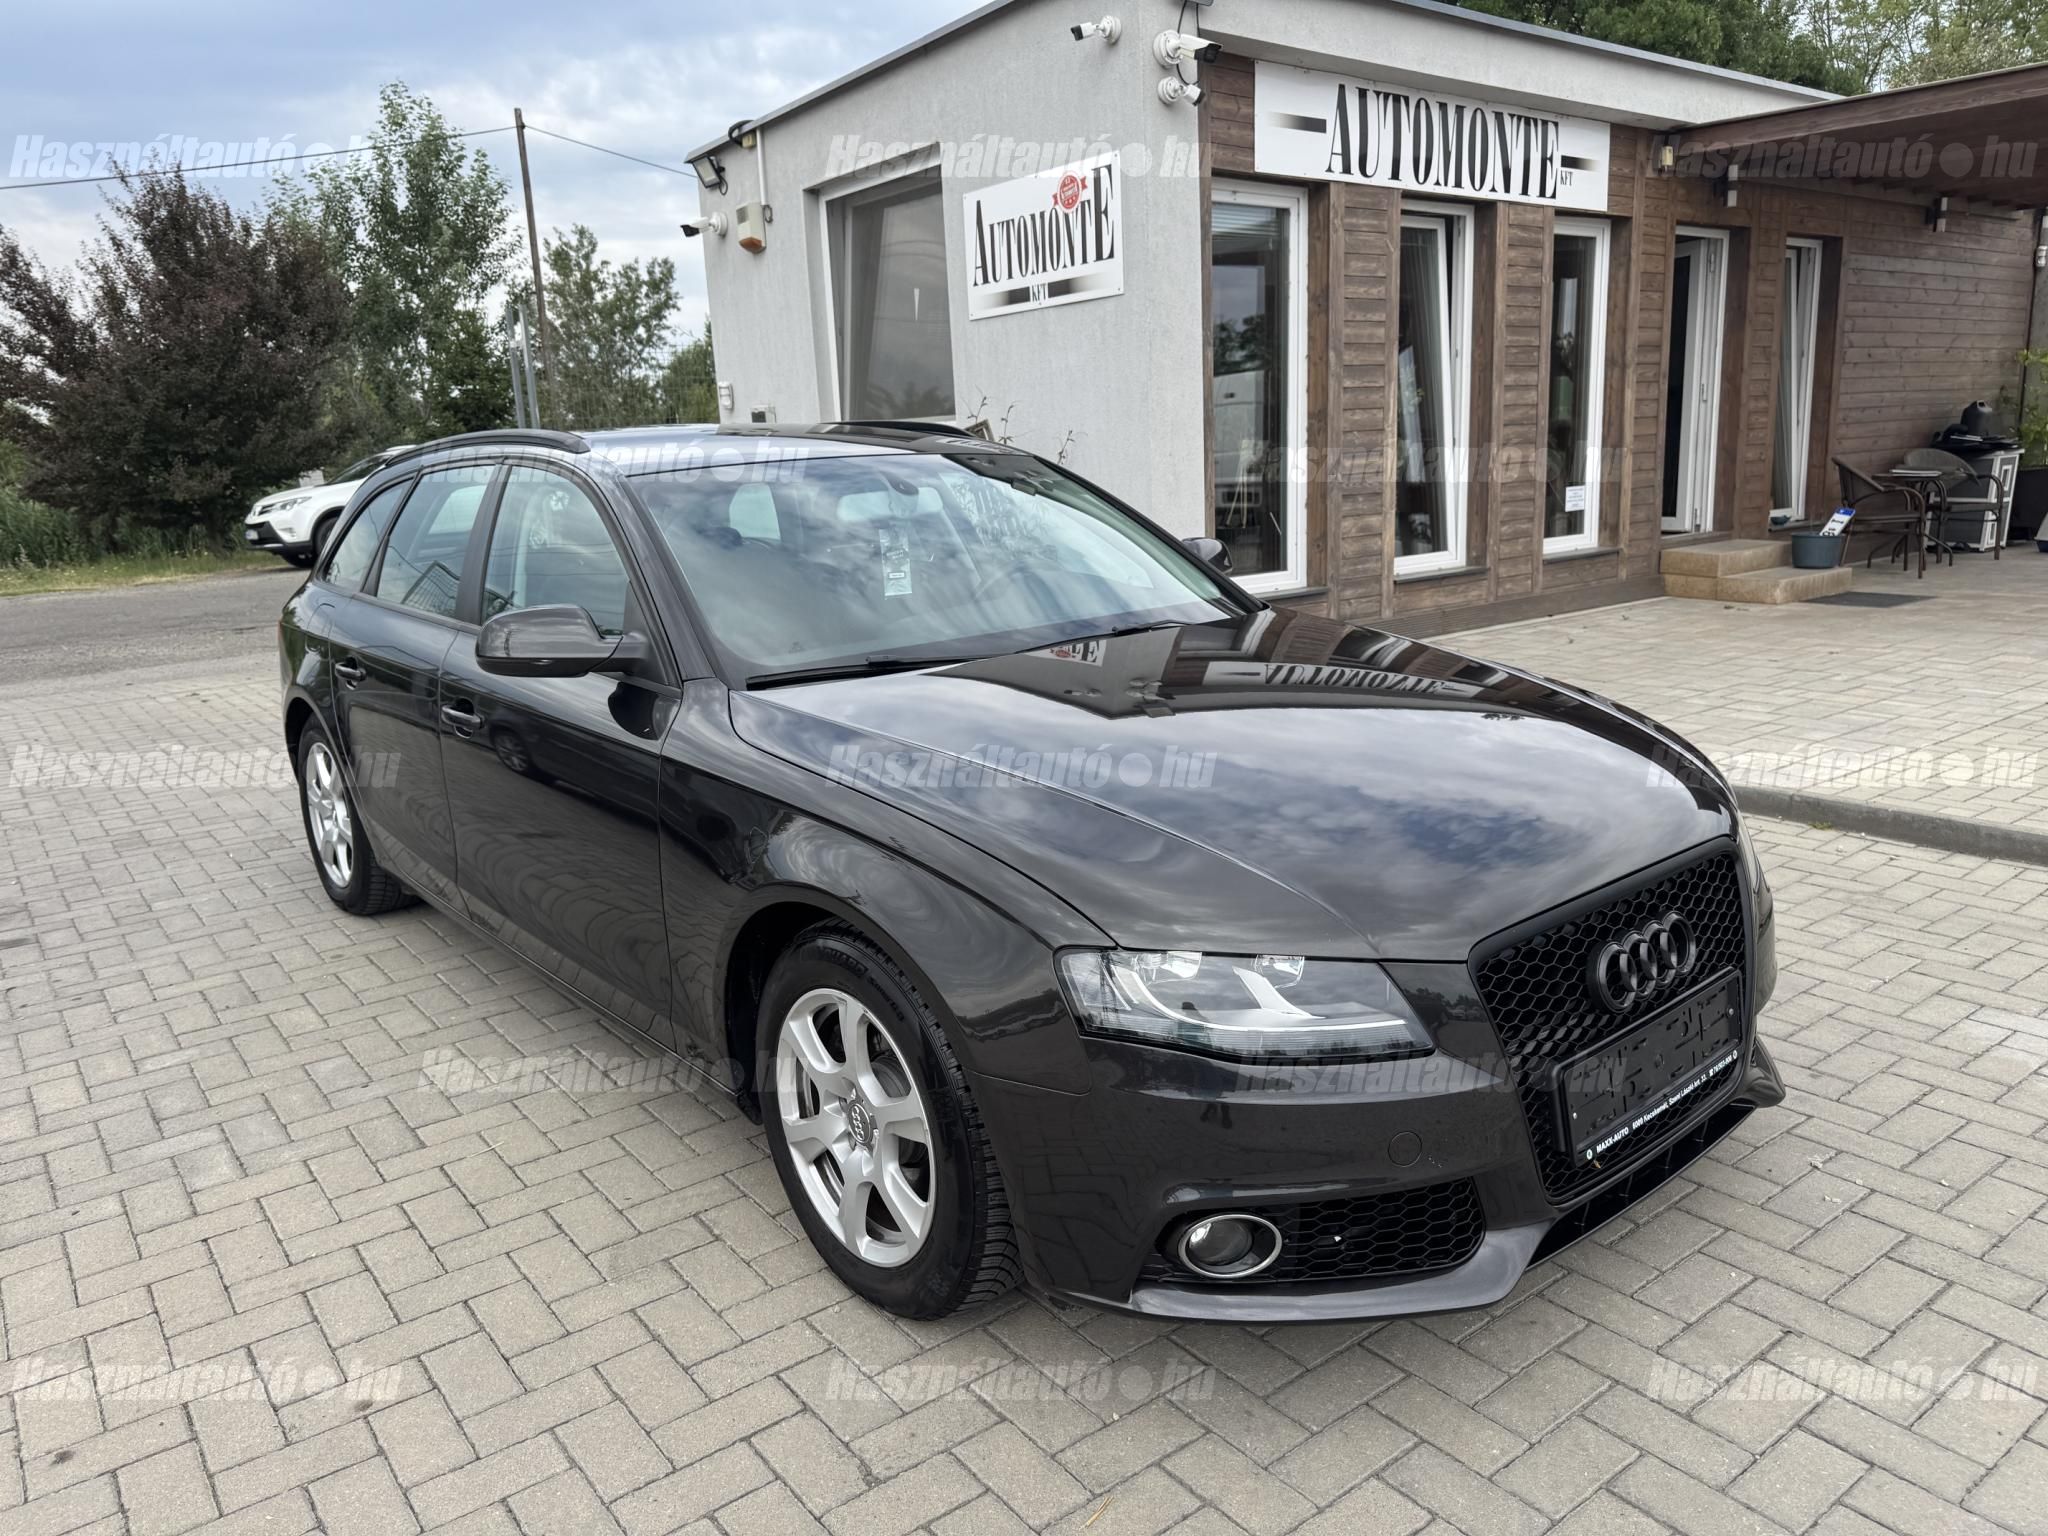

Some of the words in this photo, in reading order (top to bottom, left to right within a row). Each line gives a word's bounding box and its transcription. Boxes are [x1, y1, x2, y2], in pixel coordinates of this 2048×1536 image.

[1325, 83, 1559, 199] AUTOMONTE
[1560, 169, 1573, 186] KFT
[973, 163, 1115, 287] AUTOMONTE
[1031, 283, 1047, 302] KFT
[1596, 1127, 1629, 1153] MAXX-AUTO
